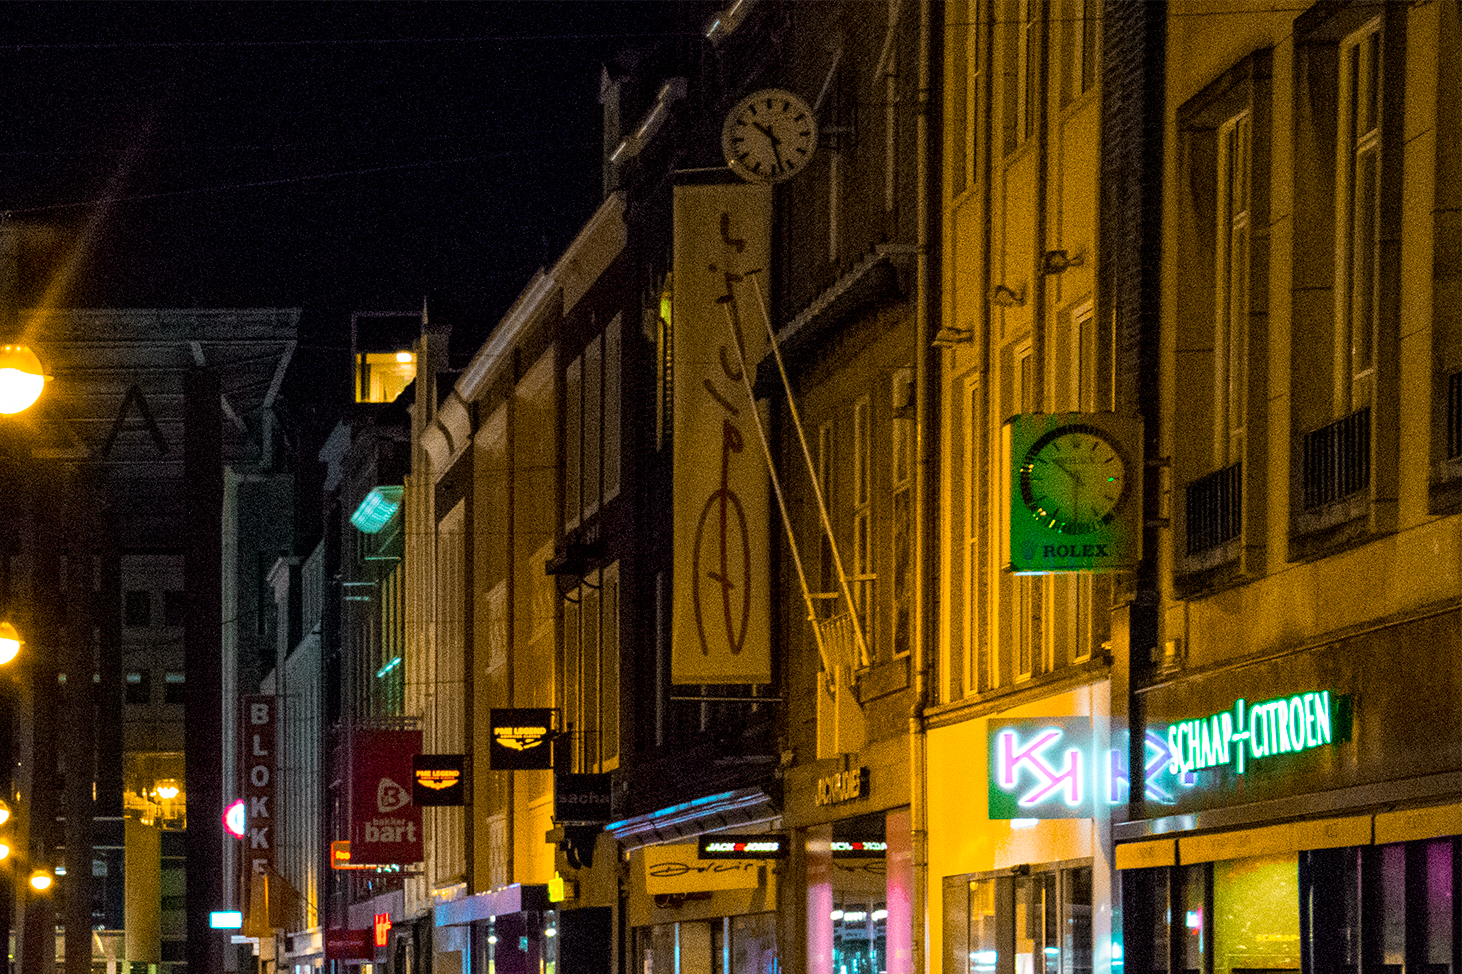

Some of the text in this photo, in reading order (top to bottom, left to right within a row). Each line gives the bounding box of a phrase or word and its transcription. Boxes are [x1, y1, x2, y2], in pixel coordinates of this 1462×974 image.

[1043, 544, 1108, 558] ROLEX
[1167, 712, 1233, 775] SCHAAP
[1249, 690, 1331, 759] CITROEN
[364, 820, 417, 843] bart
[705, 842, 780, 852] JACK JONES
